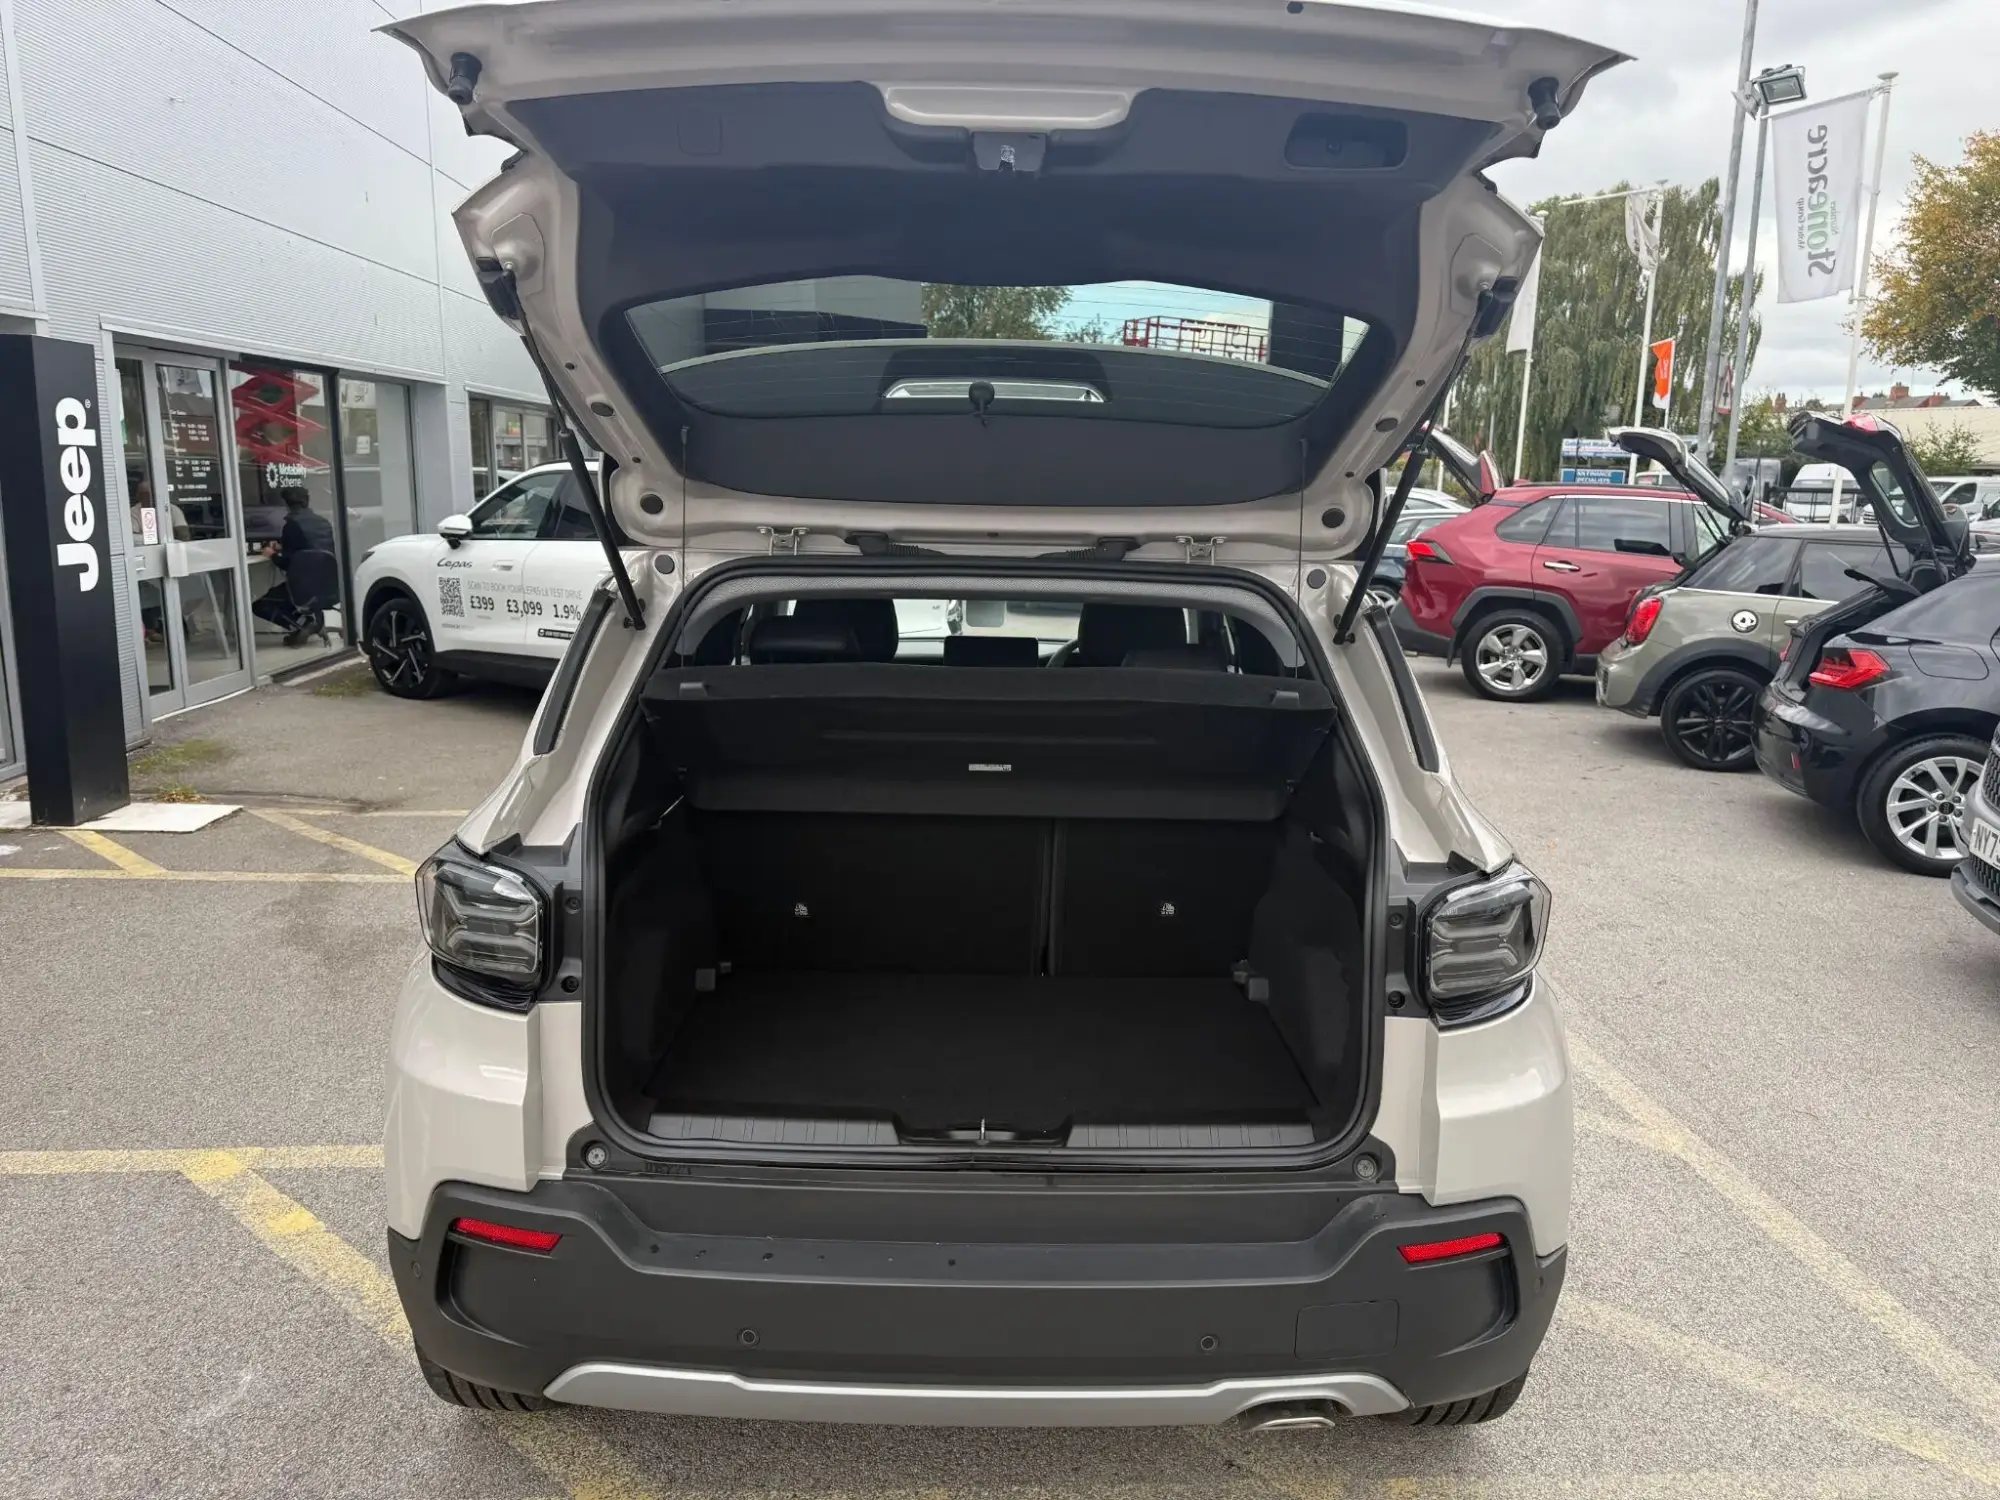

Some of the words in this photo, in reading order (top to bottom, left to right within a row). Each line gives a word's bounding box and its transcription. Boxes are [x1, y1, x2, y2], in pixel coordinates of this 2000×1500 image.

[55, 397, 99, 588] Jeep
[470, 595, 495, 611] £399
[506, 599, 543, 618] £3,099
[553, 604, 581, 620] 1.9%
